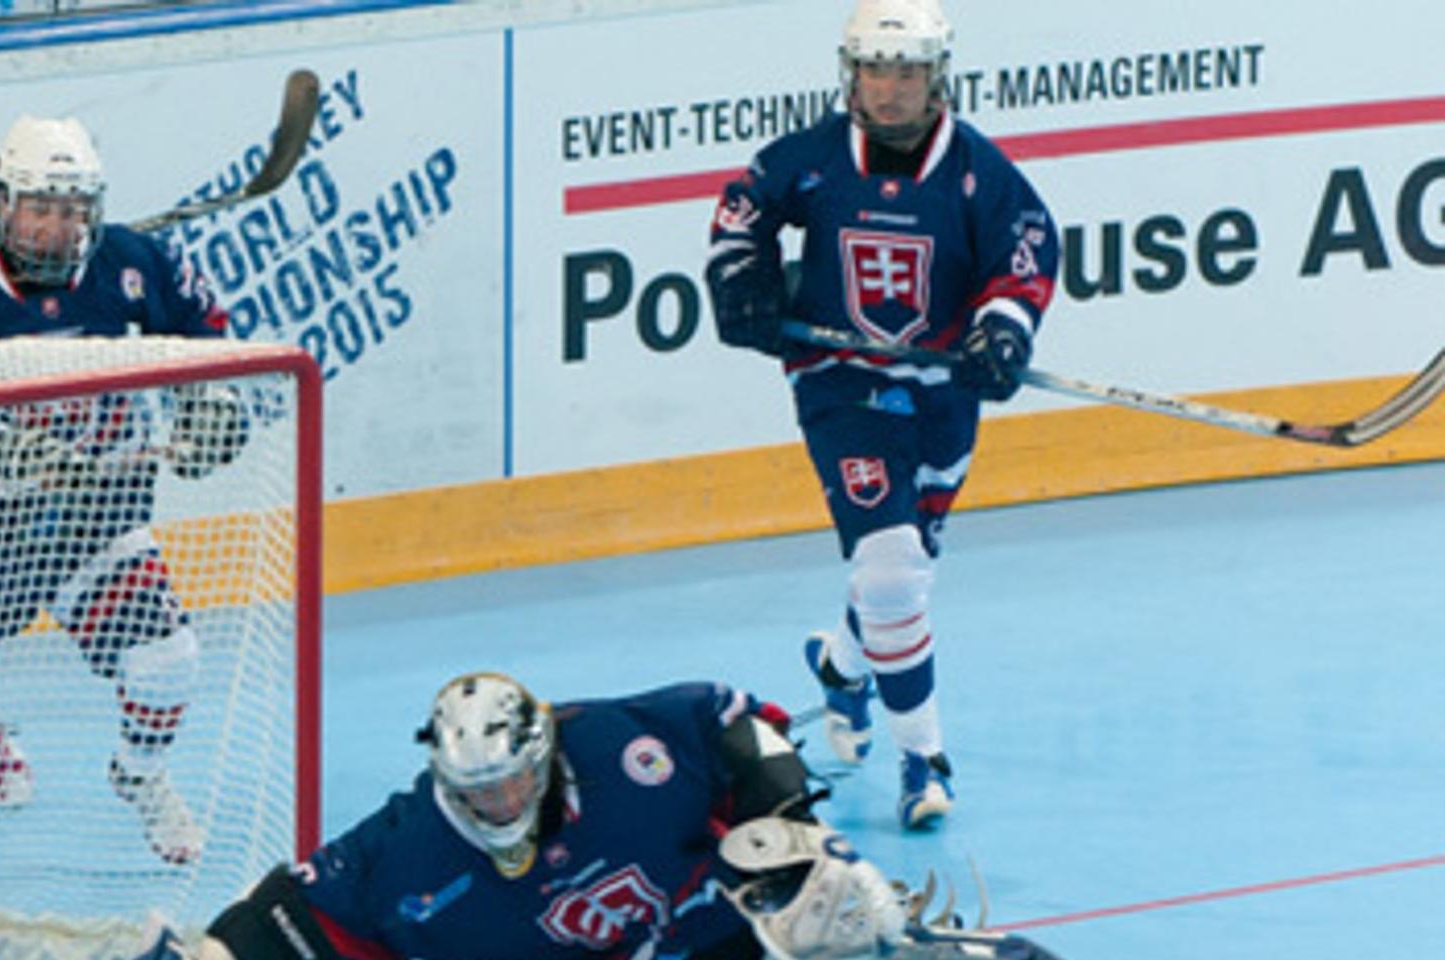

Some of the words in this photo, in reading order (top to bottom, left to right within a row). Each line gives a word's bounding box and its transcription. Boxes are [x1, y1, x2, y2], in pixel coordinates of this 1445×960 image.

[939, 45, 1265, 115] NT-MANAGEMENT
[189, 160, 339, 293] ORLD
[228, 147, 457, 341] PIONSHIP
